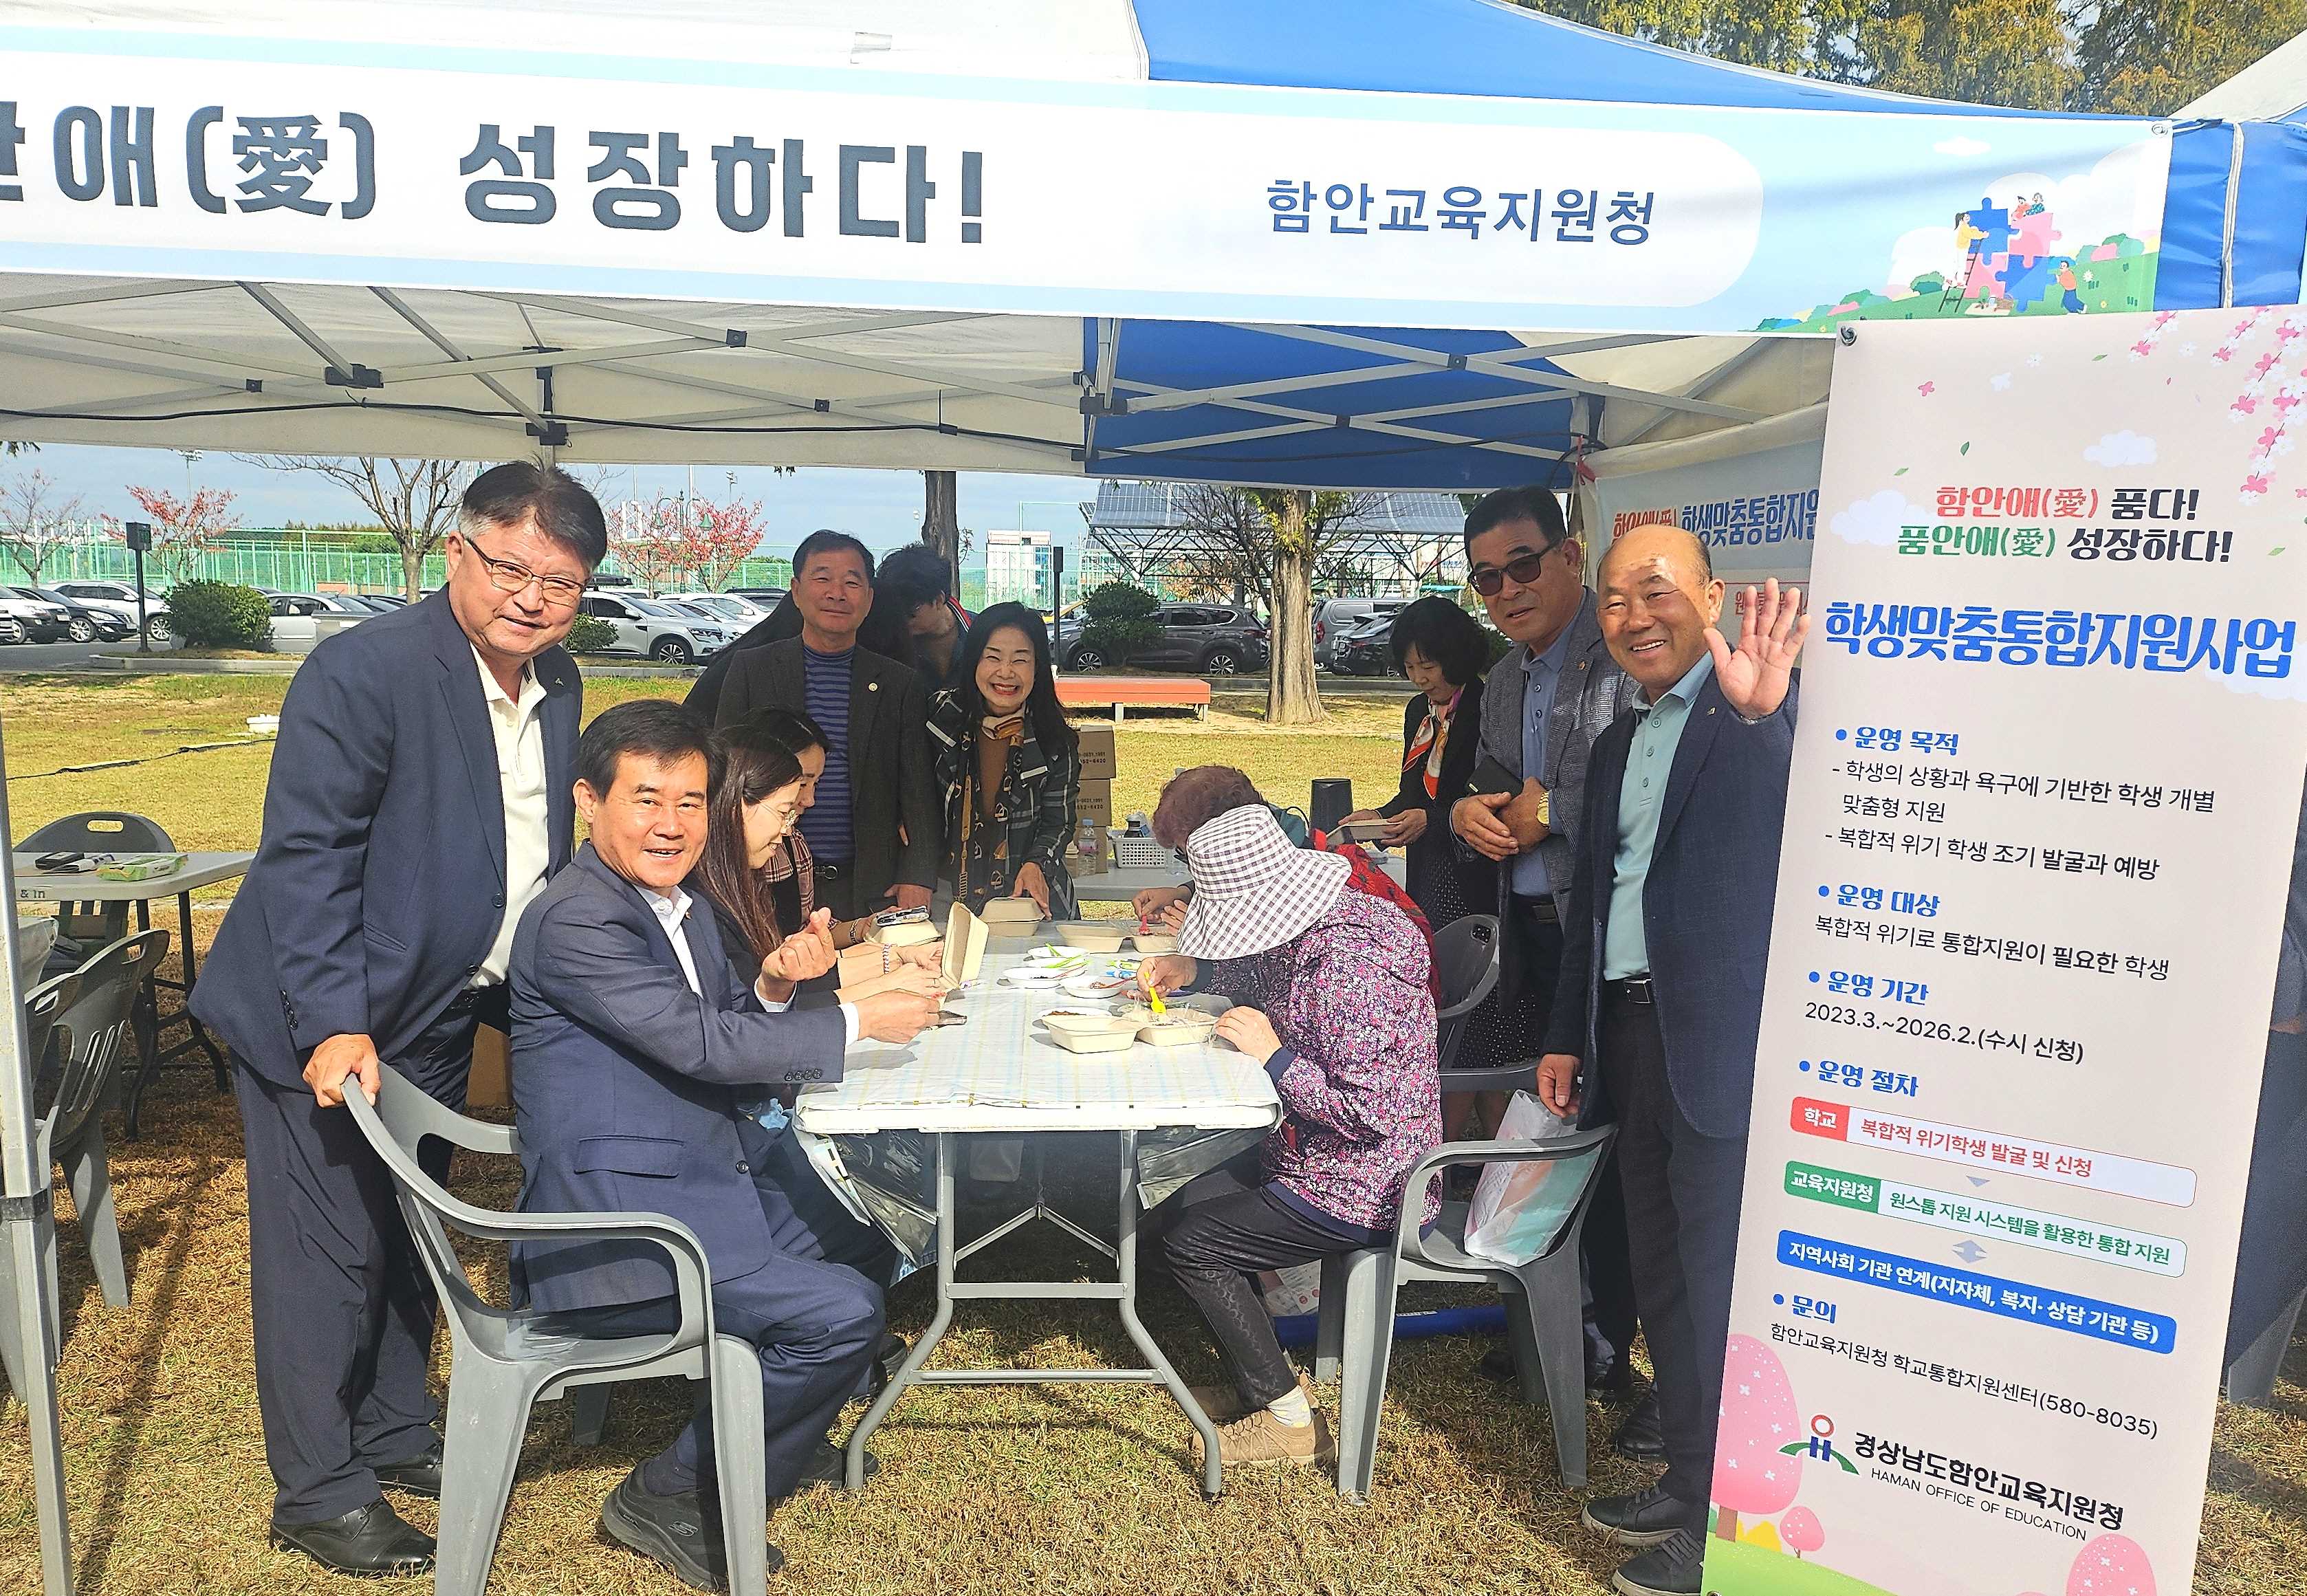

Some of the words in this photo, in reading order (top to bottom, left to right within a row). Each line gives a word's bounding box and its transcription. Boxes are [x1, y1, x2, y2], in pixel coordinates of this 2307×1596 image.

[460, 124, 982, 243] 성장하다!
[1267, 180, 1654, 245] 함안교육지원청
[1937, 488, 2098, 518] 함안애(愛)
[2111, 489, 2199, 520] 품다!
[1898, 526, 2055, 557] 품안애(愛)
[2067, 528, 2233, 562] 성장하다!
[1826, 602, 2296, 678] 학생맞춤통합지원사업
[1855, 728, 1901, 751] 운영
[1910, 732, 1958, 756] 목적
[1844, 795, 1899, 818] 맞춤형
[1905, 801, 1945, 822] 지원
[1847, 761, 1902, 785] 학생의
[1910, 767, 1970, 791] 상황과
[1976, 772, 2039, 797] 욕구에
[2045, 778, 2112, 803] 기반한
[2119, 784, 2162, 807] 학생
[2169, 789, 2214, 813] 개별
[1839, 827, 1894, 852] 복합적
[1901, 835, 1940, 857] 위기
[1948, 839, 1987, 862] 학생
[1993, 845, 2035, 868] 조기
[2043, 849, 2108, 875] 발굴과
[2114, 857, 2160, 880] 예방
[1837, 885, 1883, 910] 운영
[1892, 891, 1940, 917] 대상
[1815, 915, 1870, 941] 복합적
[1877, 925, 1935, 948] 위기로
[1942, 932, 2045, 965] 통합지원이
[2053, 947, 2119, 974] 필요한
[2125, 956, 2169, 980] 학생
[1828, 972, 1873, 997] 운영
[1881, 979, 1929, 1005] 기간
[1806, 1003, 2026, 1054] 2023.3.~2026.2.(수시
[2034, 1038, 2083, 1064] 신청)
[1818, 1061, 1863, 1087] 운영
[1871, 1070, 1918, 1097] 절차
[1804, 1107, 1837, 1129] 학교
[1860, 1119, 1911, 1146] 복합적
[1916, 1130, 1986, 1159] 위기학생
[1992, 1144, 2027, 1166] 발굴
[2033, 1151, 2050, 1170] 및
[2055, 1156, 2091, 1177] 신청
[1791, 1170, 1873, 1203] 교육지원청
[1890, 1193, 1936, 1215] 원스톱
[1940, 1203, 1971, 1223] 지원
[1973, 1210, 2040, 1238] 시스템을
[2043, 1223, 2095, 1251] 활용한
[2097, 1235, 2132, 1258] 통합
[2134, 1244, 2169, 1265] 지원
[1789, 1243, 1855, 1273] 지역사회
[1857, 1257, 1893, 1281] 기관
[1896, 1264, 1996, 1306] 연계(지자체,
[2048, 1302, 2086, 1328] 상담
[2088, 1311, 2128, 1335] 기관
[2131, 1320, 2158, 1344] 등)
[1792, 1296, 1836, 1324] 문의
[1771, 1323, 1887, 1367] 함안교육지원청
[1894, 1355, 2156, 1439] 학교통합지원센터(580-8035)
[1855, 1432, 2124, 1531] 경상남도함안교육지원청
[1872, 1468, 1920, 1491] HAMAN
[1926, 1485, 1975, 1507] OFFICE
[1981, 1500, 2000, 1513] OF
[2005, 1507, 2086, 1541] EDUCATION
